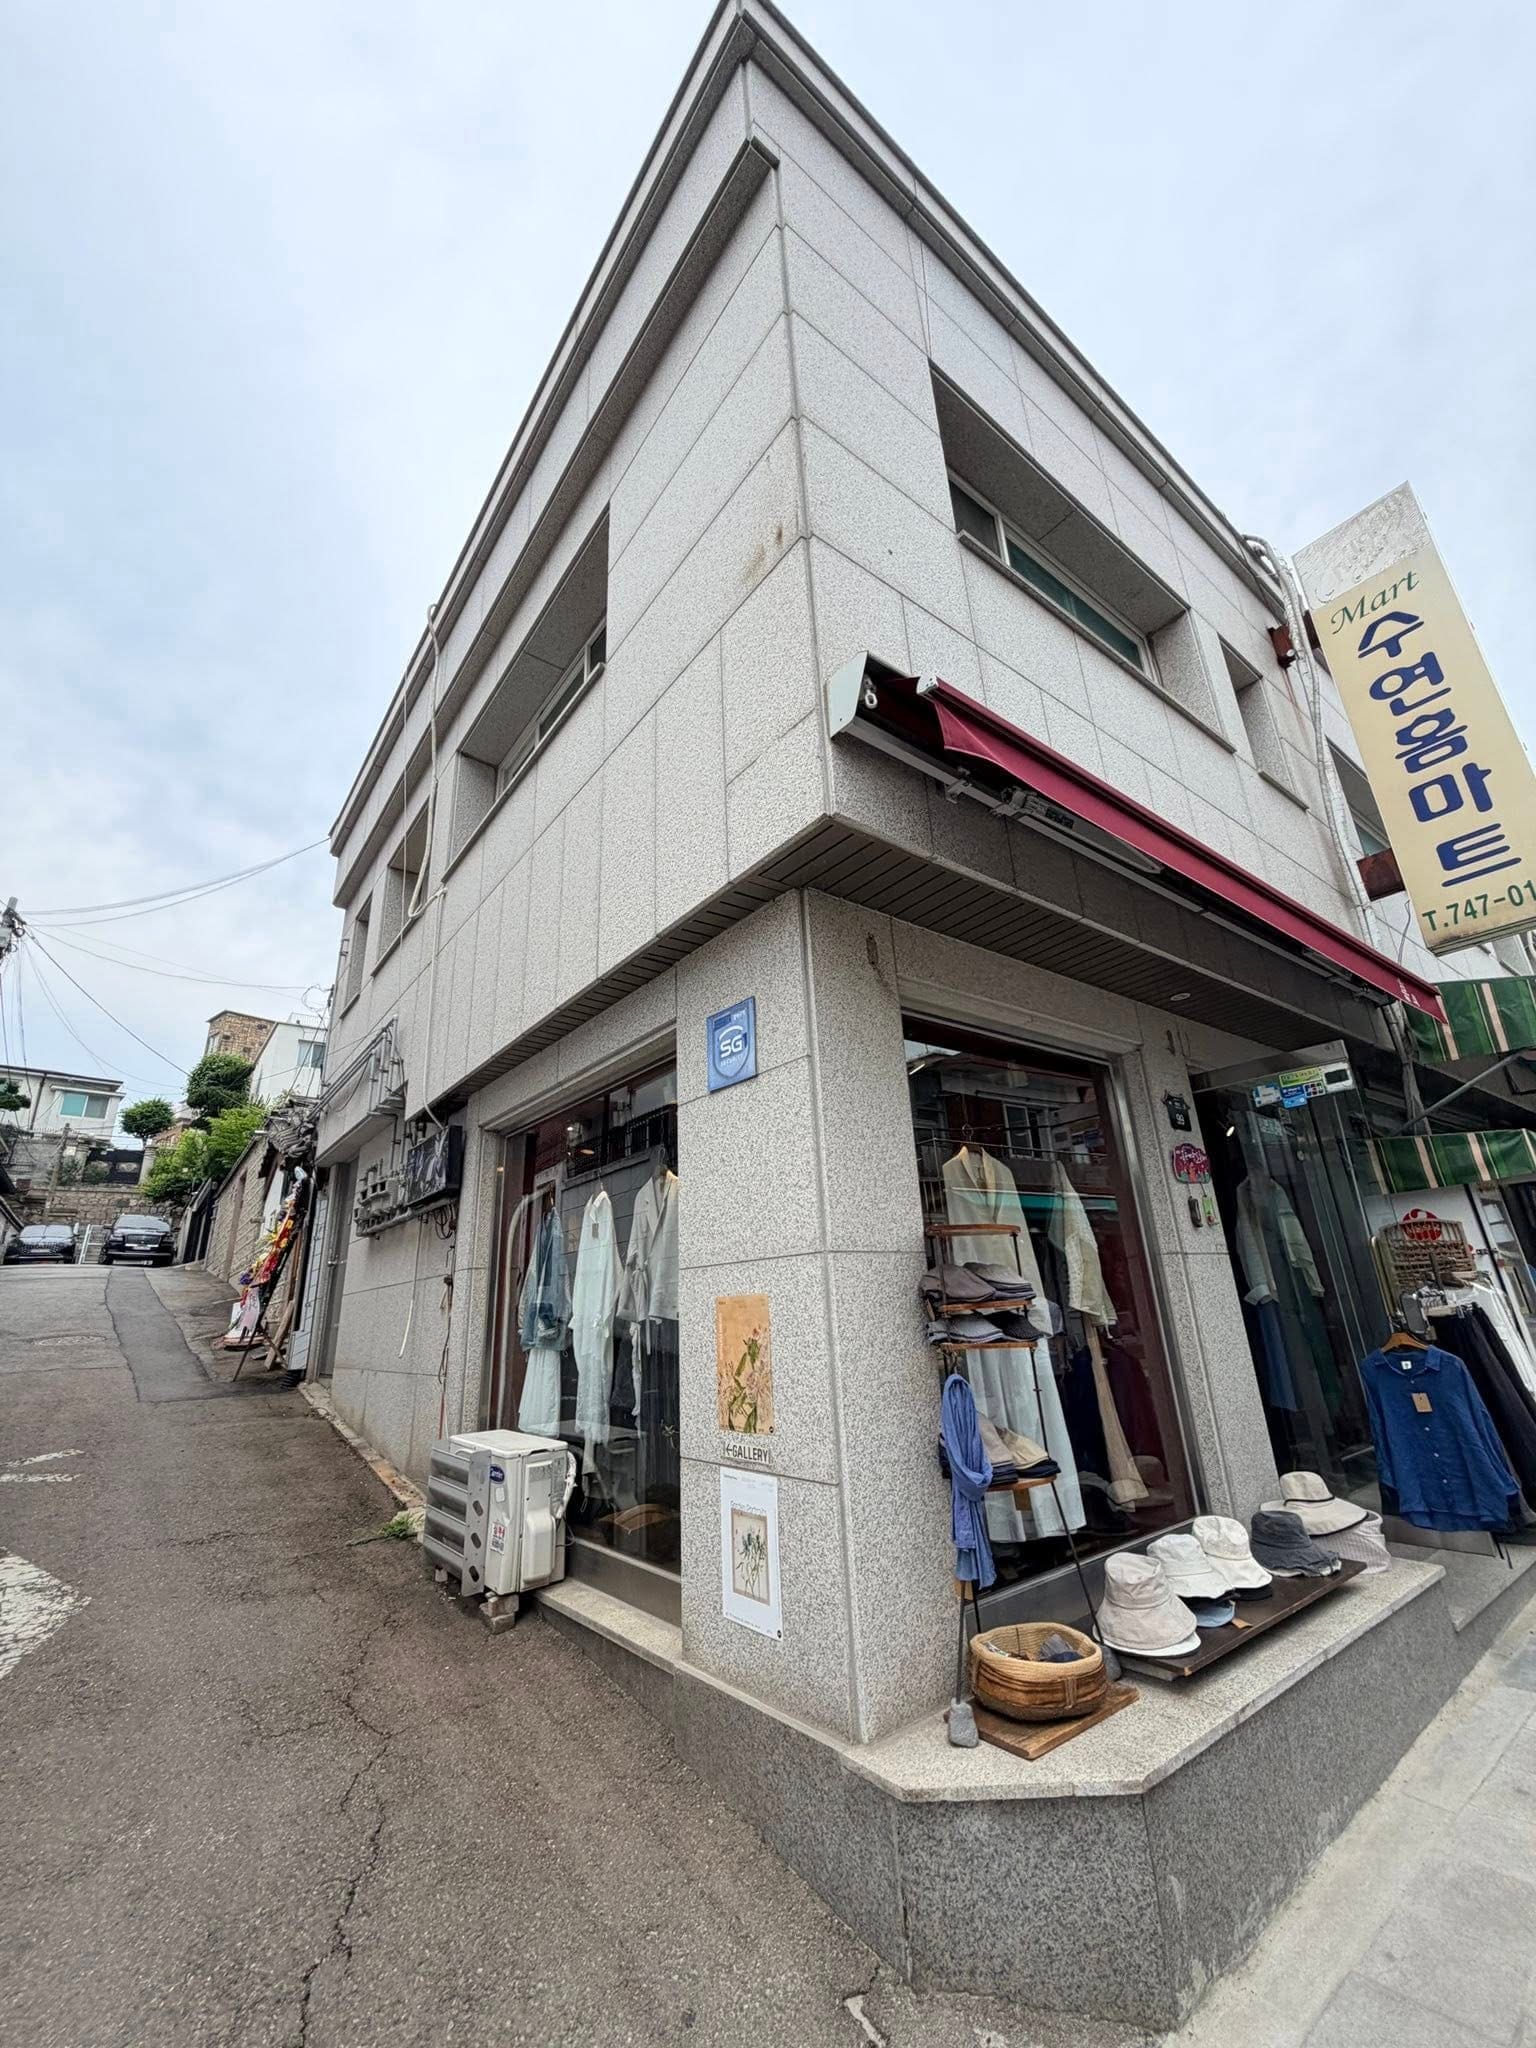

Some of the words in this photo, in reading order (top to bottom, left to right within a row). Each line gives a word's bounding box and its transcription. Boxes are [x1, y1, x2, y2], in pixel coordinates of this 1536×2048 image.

[1331, 571, 1419, 635] Mart
[1357, 610, 1522, 888] 수연홈마트
[720, 1033, 743, 1058] SG
[732, 1444, 768, 1462] GALLERY
